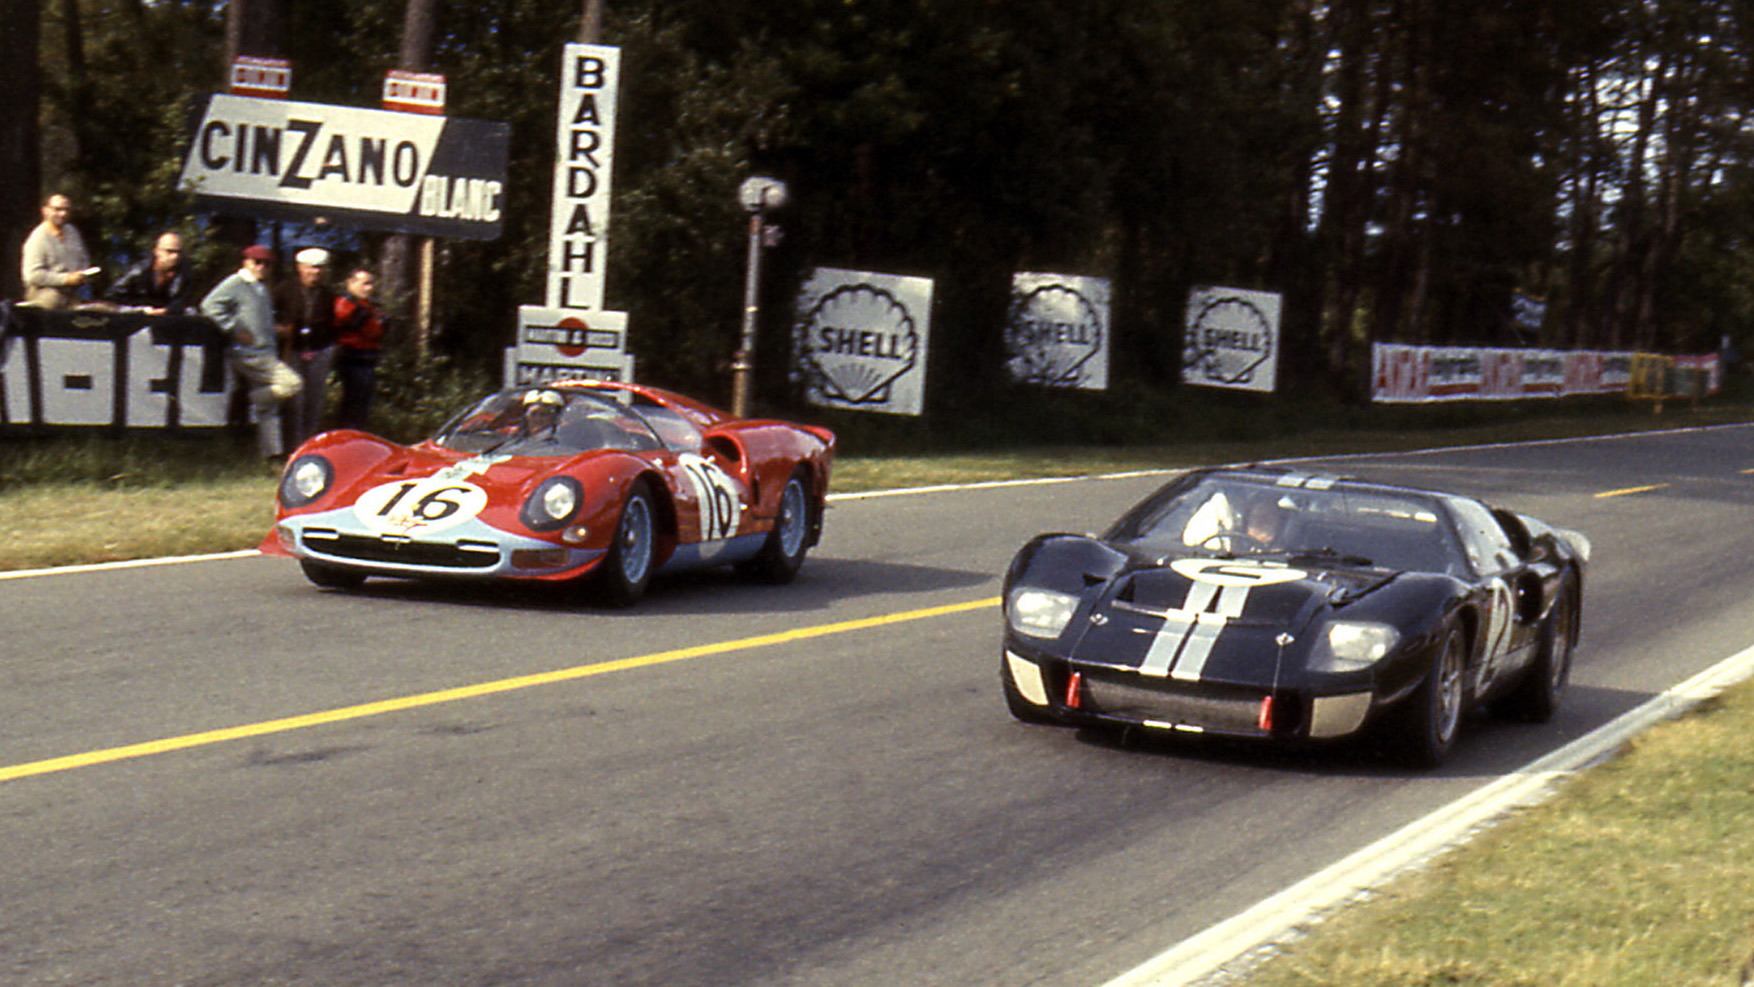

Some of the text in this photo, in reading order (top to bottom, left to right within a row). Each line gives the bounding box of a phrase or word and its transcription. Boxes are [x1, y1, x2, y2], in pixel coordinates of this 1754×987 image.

[201, 118, 418, 189] CINZANO
[420, 174, 502, 222] BLANC
[560, 56, 605, 310] BARDAHL
[820, 326, 902, 359] SHELL
[1204, 328, 1261, 351] SHELL
[377, 483, 472, 520] 16
[684, 463, 732, 540] 16
